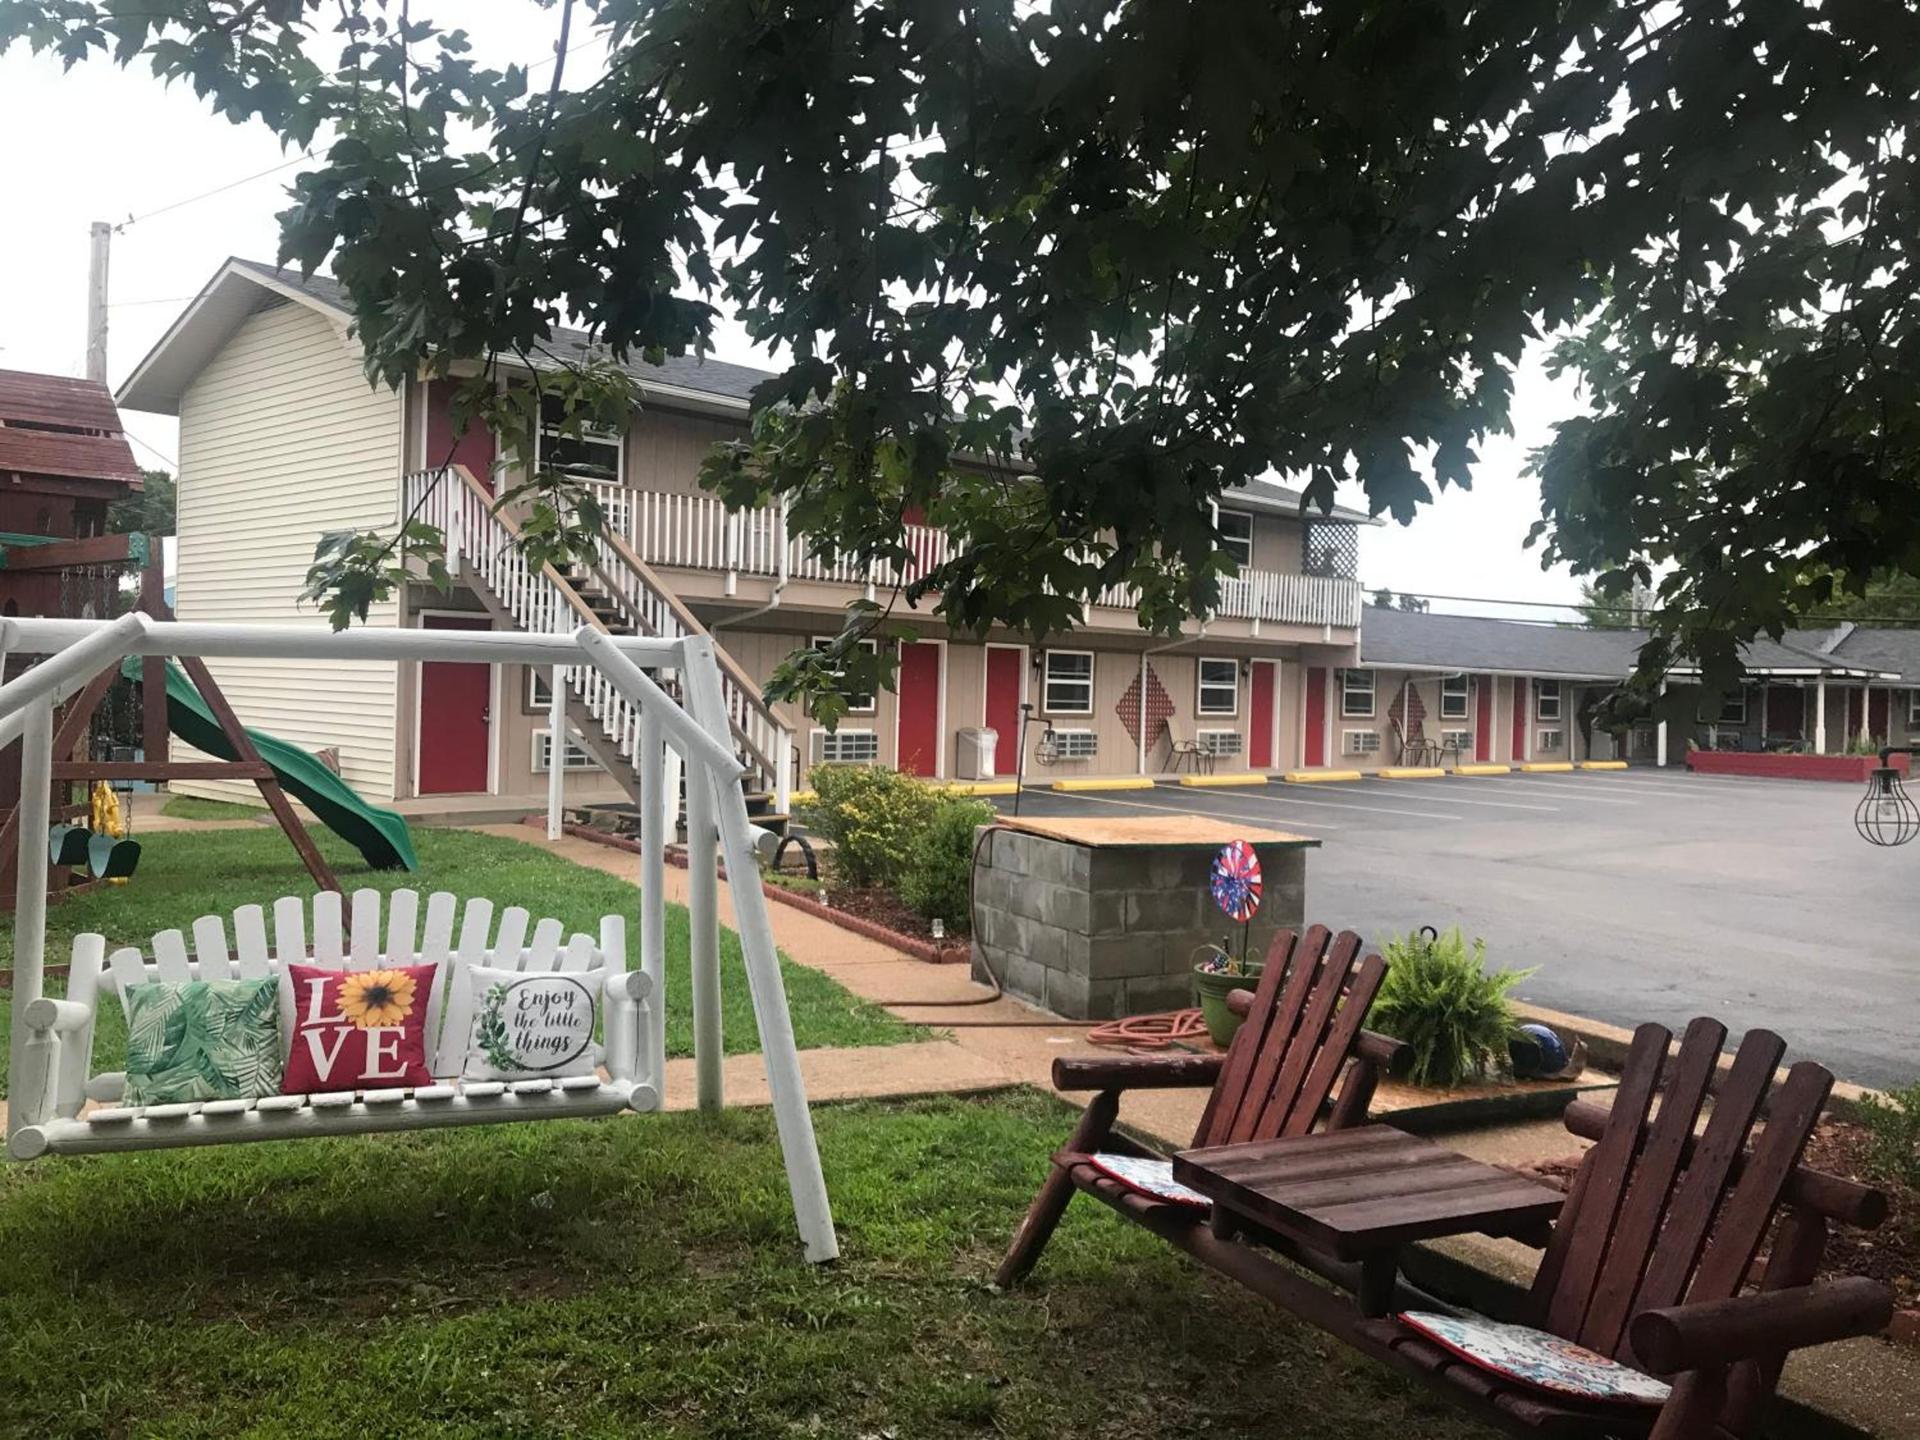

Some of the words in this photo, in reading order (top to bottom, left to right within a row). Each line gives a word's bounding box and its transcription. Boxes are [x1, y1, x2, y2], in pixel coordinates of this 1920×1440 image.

[518, 988, 575, 1017] Enjoy
[514, 1011, 536, 1029] the
[544, 1011, 581, 1028] little
[515, 1029, 570, 1055] things
